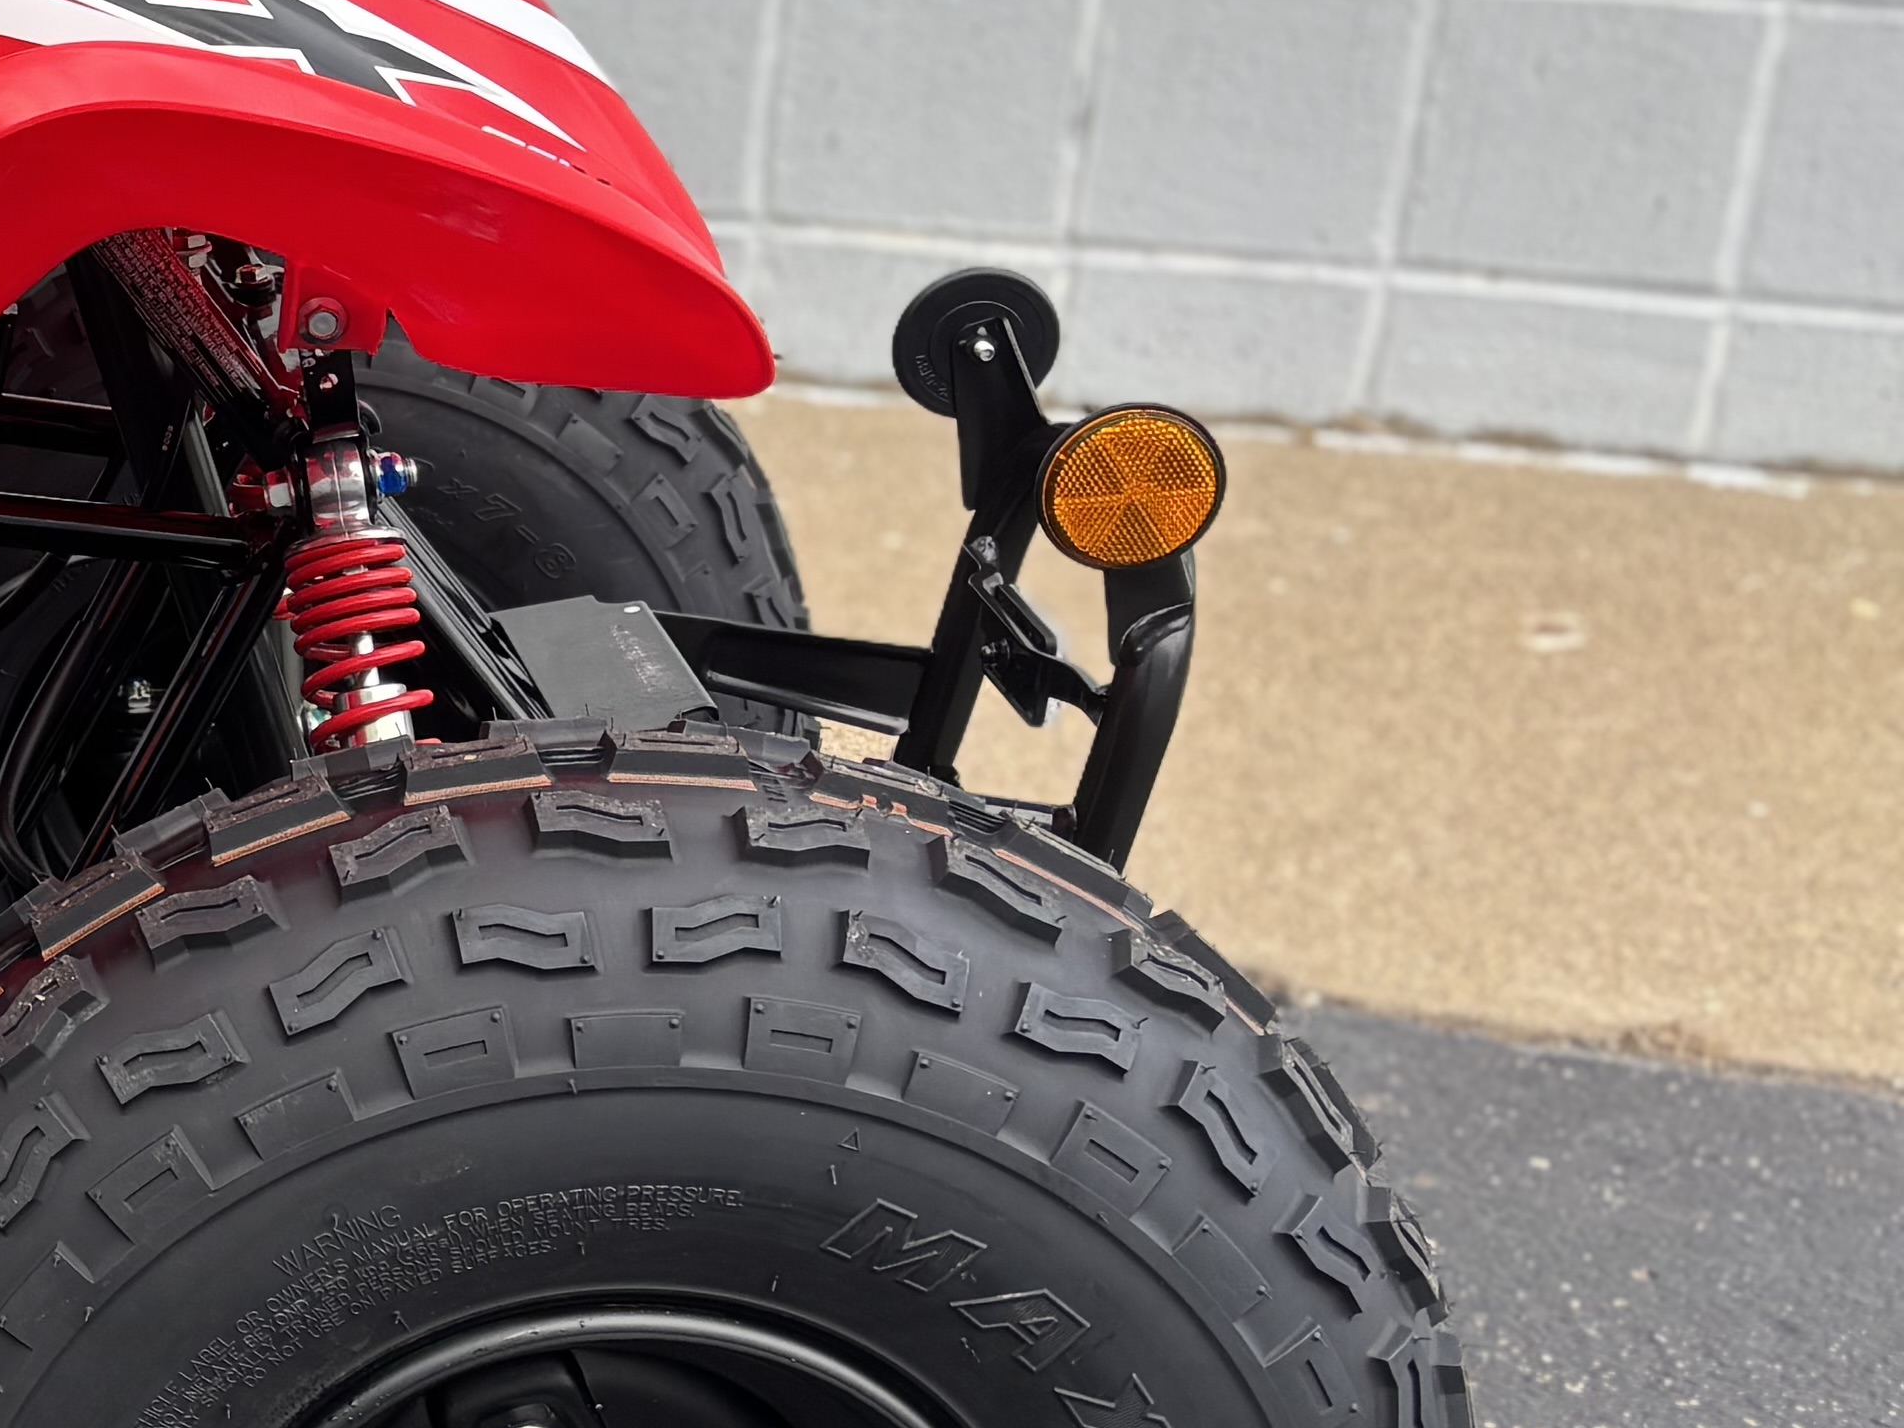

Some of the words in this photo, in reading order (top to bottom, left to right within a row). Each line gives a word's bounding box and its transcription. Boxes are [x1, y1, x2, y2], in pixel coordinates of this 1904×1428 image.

[177, 1331, 236, 1384] LABEL
[231, 1307, 267, 1336] OR
[260, 1254, 351, 1314] OWNER'S
[351, 1219, 438, 1265] MANUAL
[442, 1205, 491, 1232] FOR
[495, 1185, 616, 1218] OPERATING
[627, 1183, 748, 1209] PRESSURE.
[181, 1345, 244, 1404] INFLATE
[241, 1295, 313, 1350] BEYOND
[313, 1274, 352, 1301] 250
[470, 1214, 525, 1238] WHEN
[531, 1204, 615, 1226] SEATING
[626, 1200, 698, 1221] BEADS.
[197, 1334, 281, 1410] SPECIALLY
[279, 1289, 353, 1340] TRAINED
[355, 1252, 444, 1296] PERSONS
[446, 1230, 524, 1260] SHOULD
[534, 1220, 600, 1239] MOUNT
[242, 1364, 270, 1388] DO
[268, 1336, 306, 1366] NOT
[307, 1310, 347, 1339] USE
[347, 1294, 377, 1316] ON
[379, 1266, 445, 1300] PAVED
[448, 1239, 558, 1274] SURFACES.
[270, 1202, 405, 1279] WARNING
